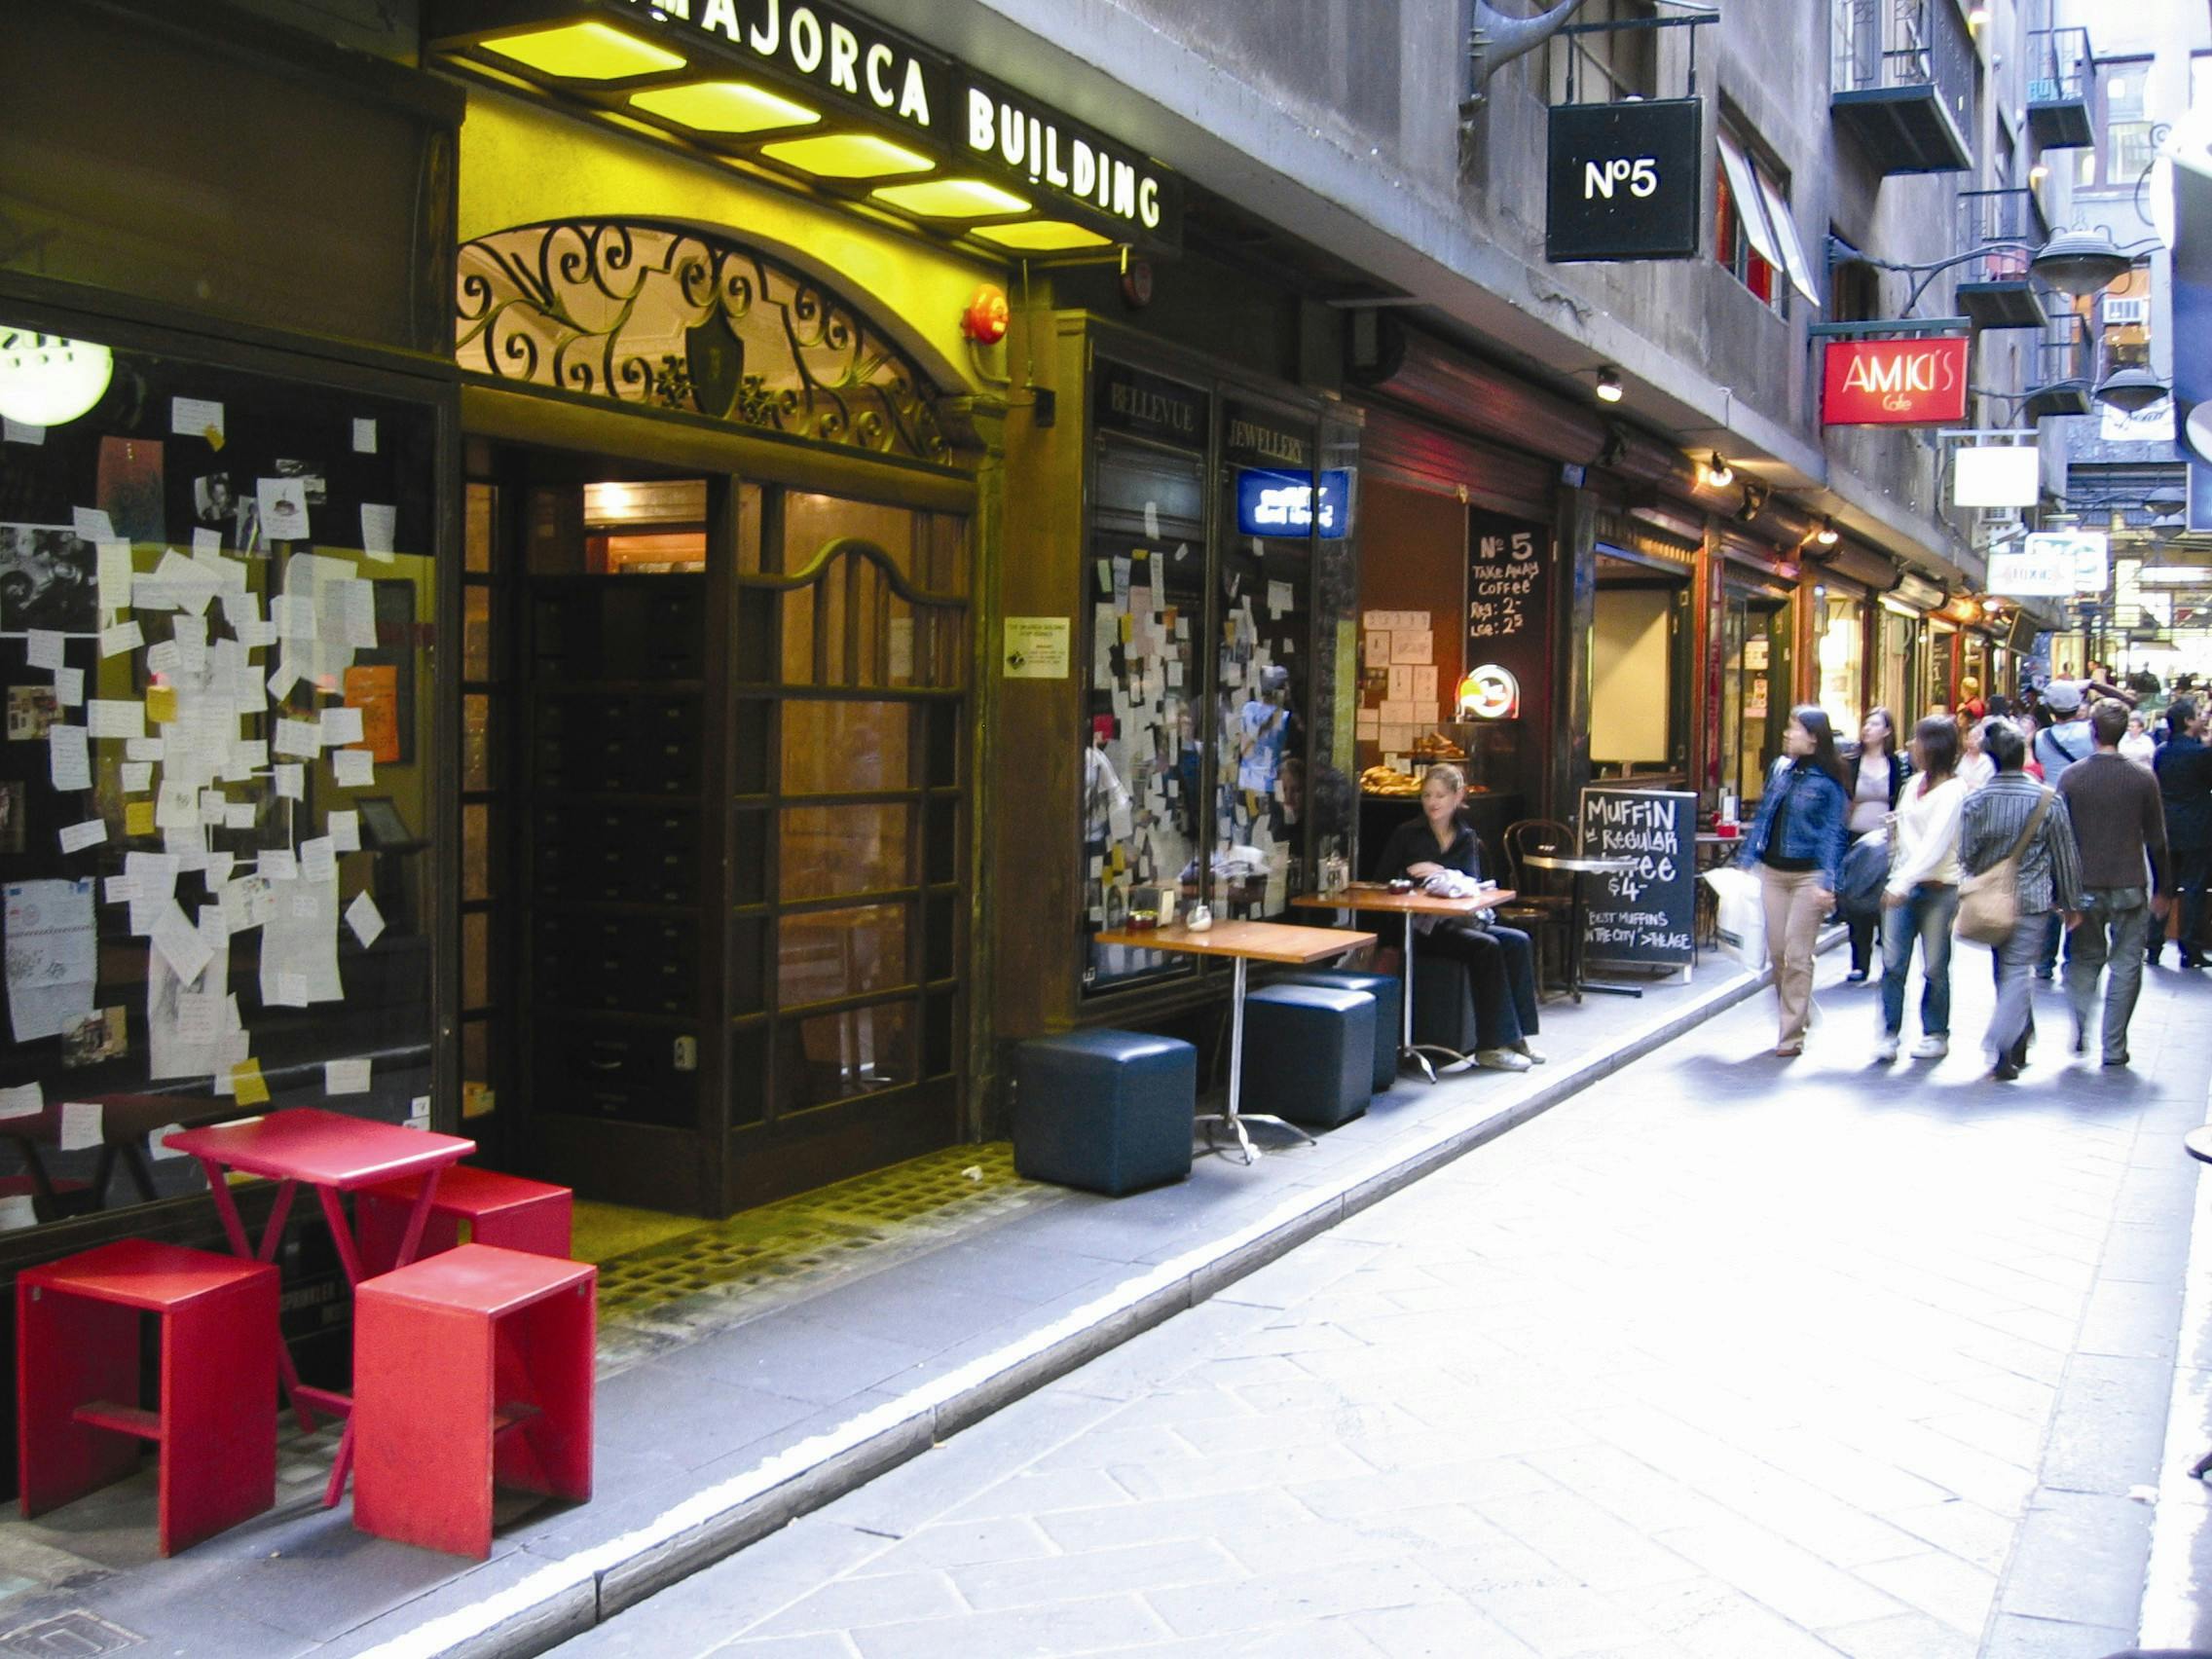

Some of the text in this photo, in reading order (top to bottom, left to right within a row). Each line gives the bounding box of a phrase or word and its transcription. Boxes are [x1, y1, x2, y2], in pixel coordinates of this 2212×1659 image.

[968, 87, 1161, 228] BUILDING
[1111, 382, 1194, 432] BELLEVUE
[1511, 533, 1533, 560] 5
